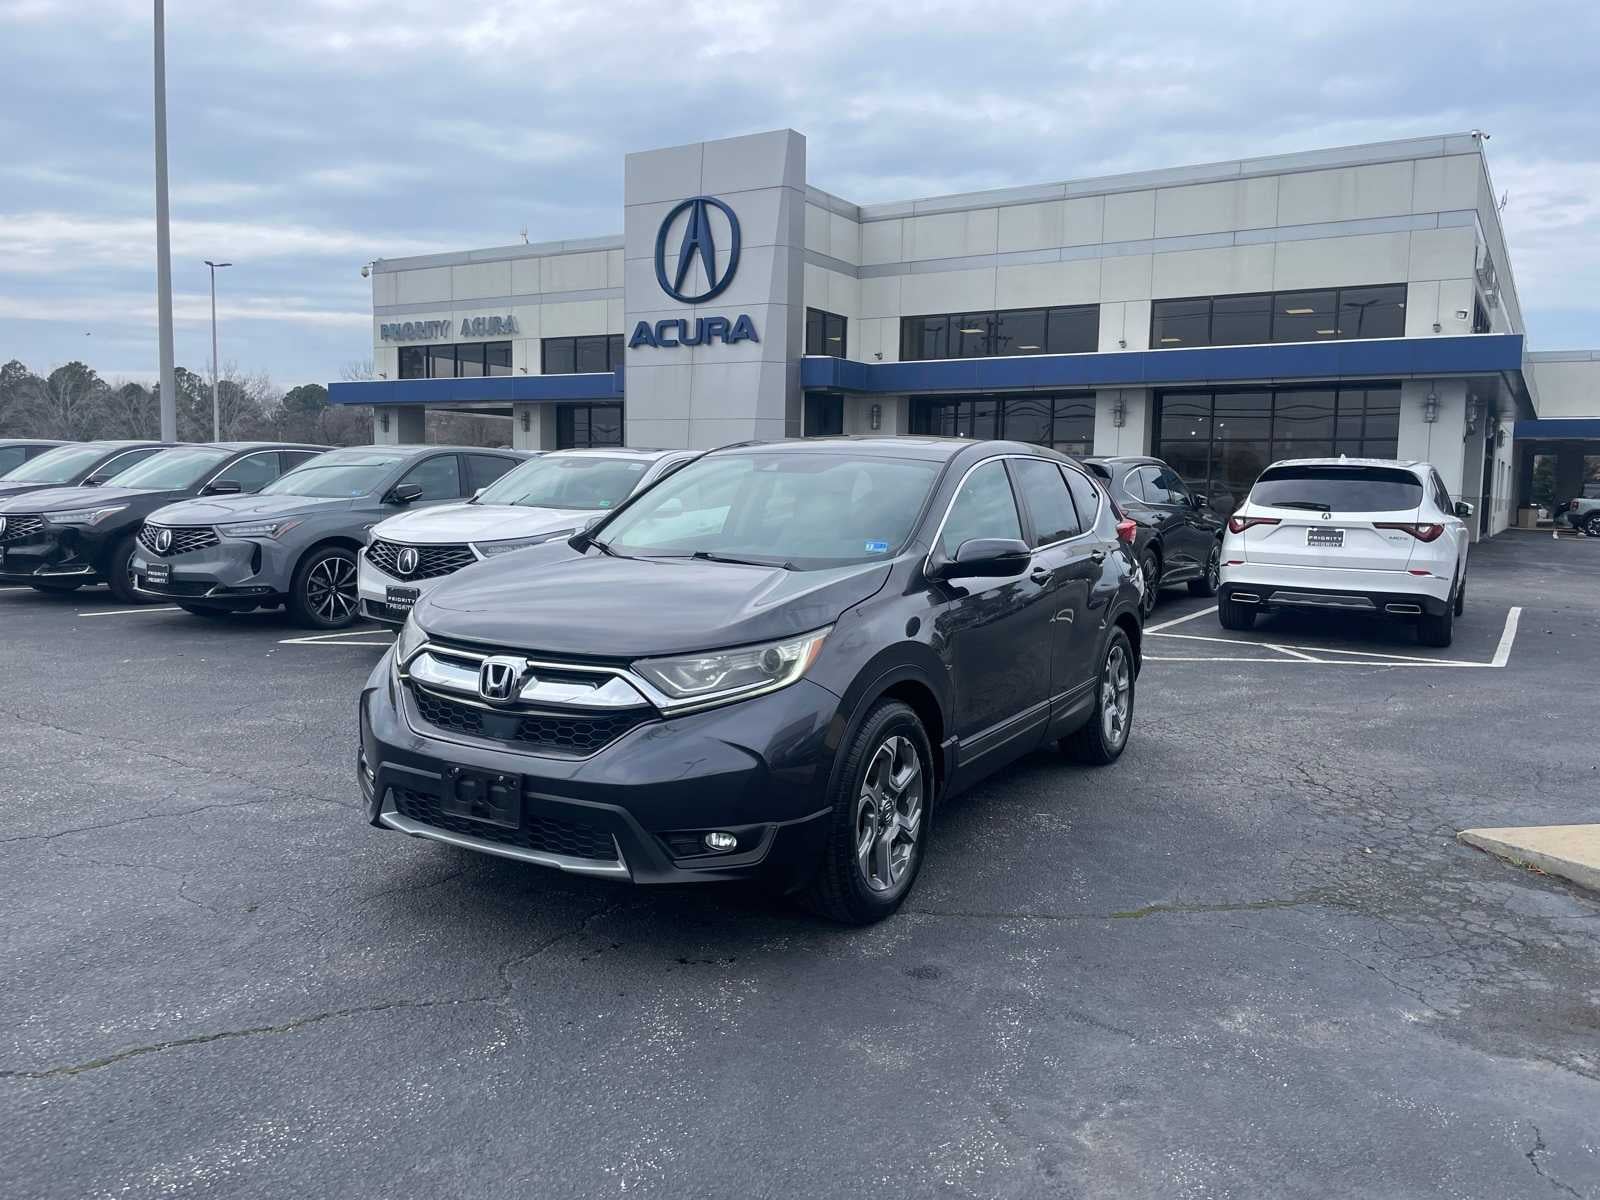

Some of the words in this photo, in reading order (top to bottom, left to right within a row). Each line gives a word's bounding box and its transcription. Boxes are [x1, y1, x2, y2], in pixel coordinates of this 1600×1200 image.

[380, 320, 450, 341] PRIORITY
[460, 315, 519, 337] ACURA
[628, 314, 760, 348] ACURA
